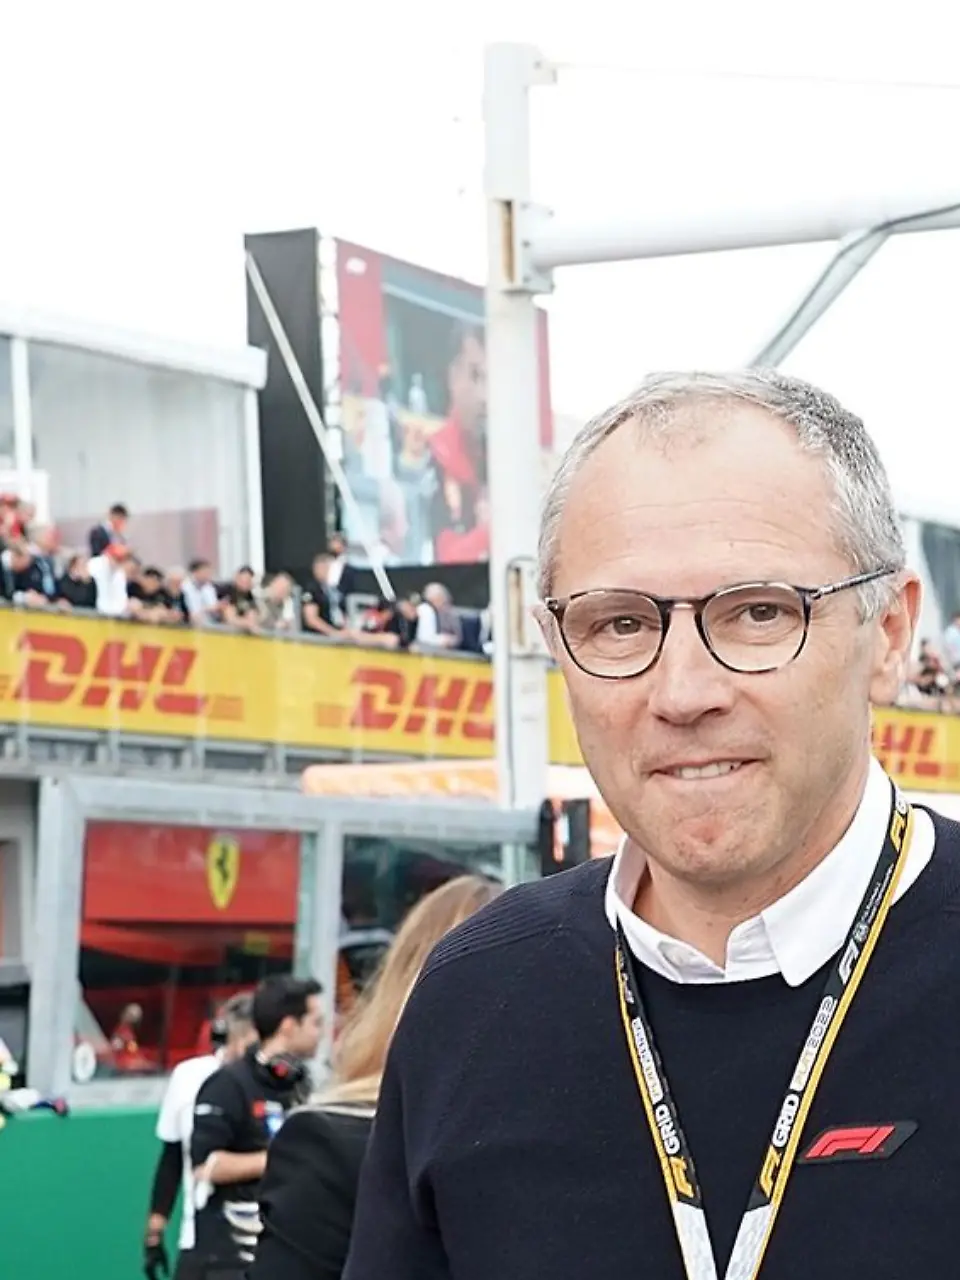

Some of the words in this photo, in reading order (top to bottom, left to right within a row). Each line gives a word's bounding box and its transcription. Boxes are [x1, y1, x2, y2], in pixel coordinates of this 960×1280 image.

[15, 630, 207, 714] DHL
[868, 724, 942, 778] HL
[655, 1103, 680, 1155] GRID
[772, 1093, 800, 1148] GRID
[804, 1125, 896, 1159] F1
